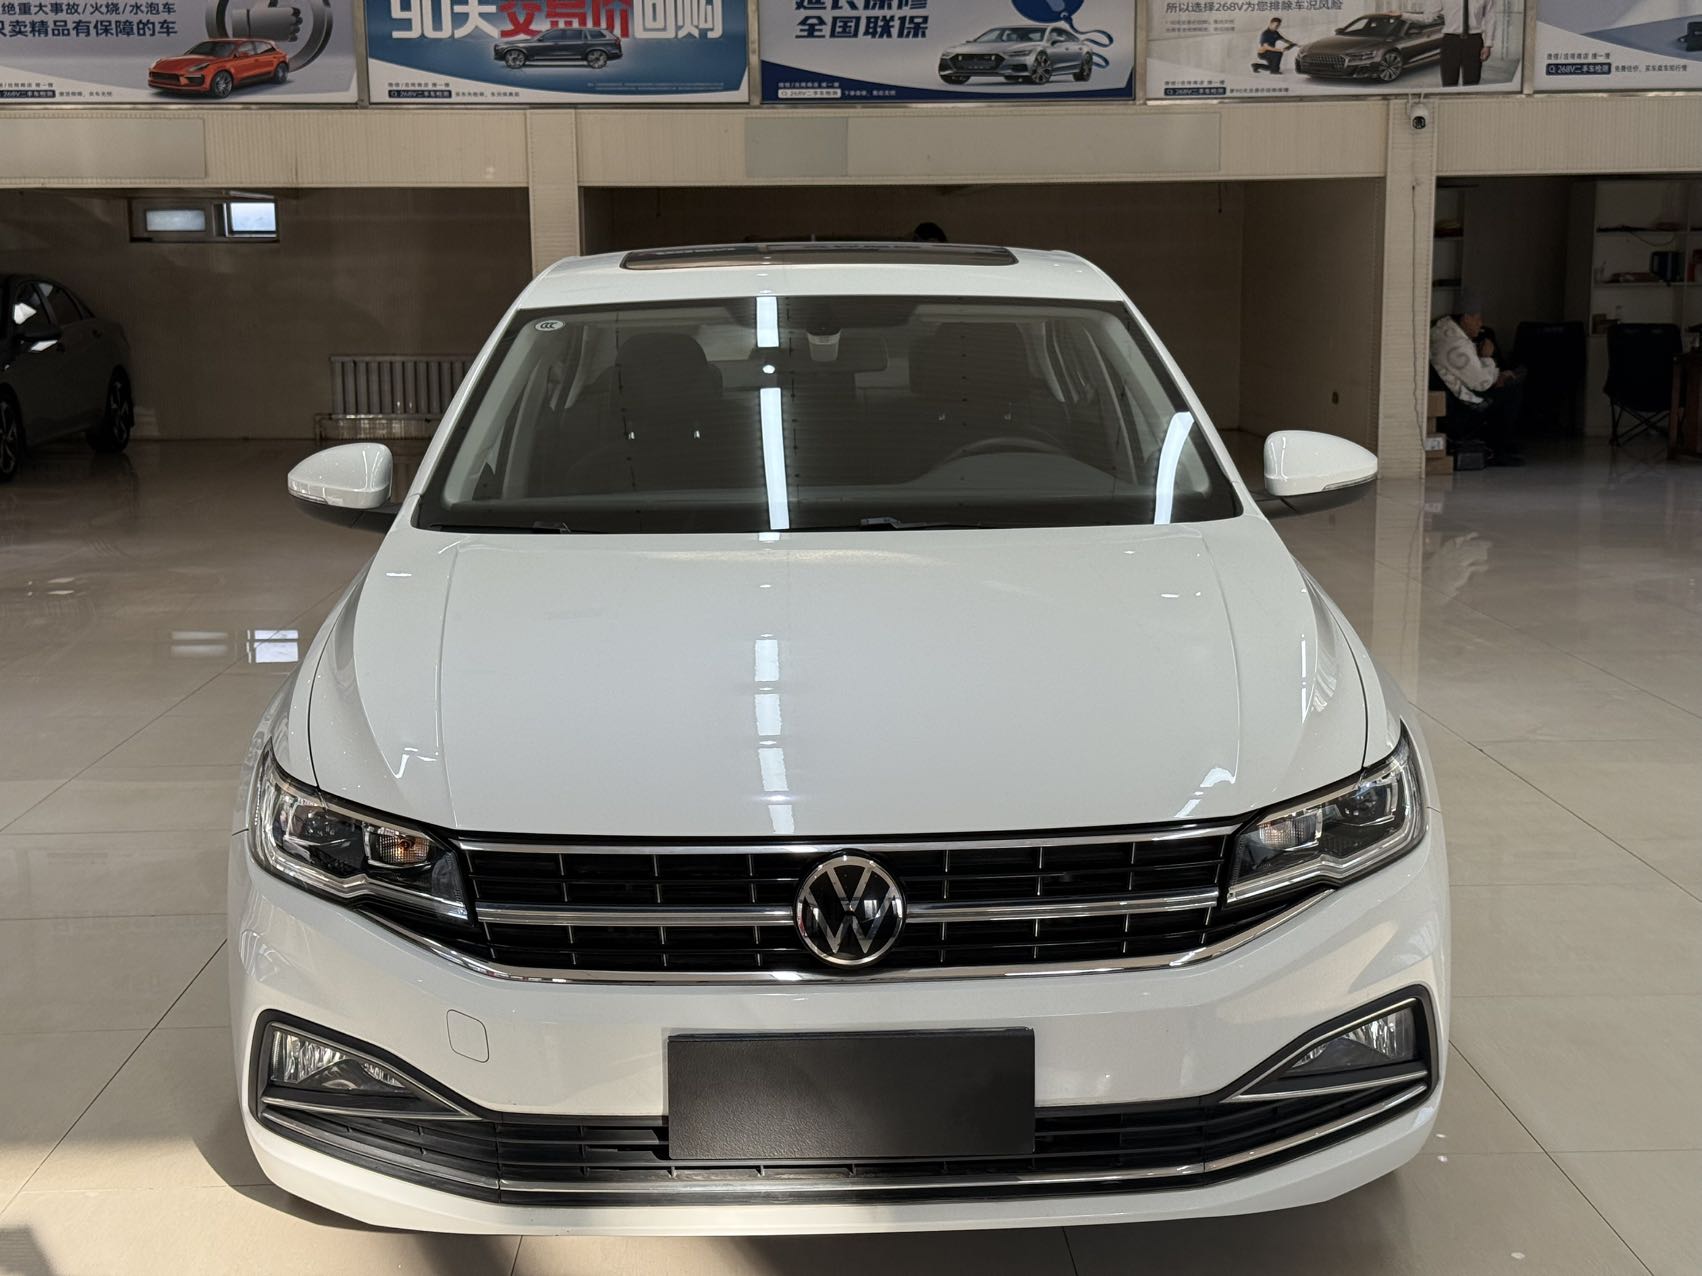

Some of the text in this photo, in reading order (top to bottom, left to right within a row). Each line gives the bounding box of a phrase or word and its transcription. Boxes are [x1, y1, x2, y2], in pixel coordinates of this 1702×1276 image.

[1, 2, 177, 16] 绝重大事故/火烧/水泡车
[794, 15, 930, 39] 全国联保
